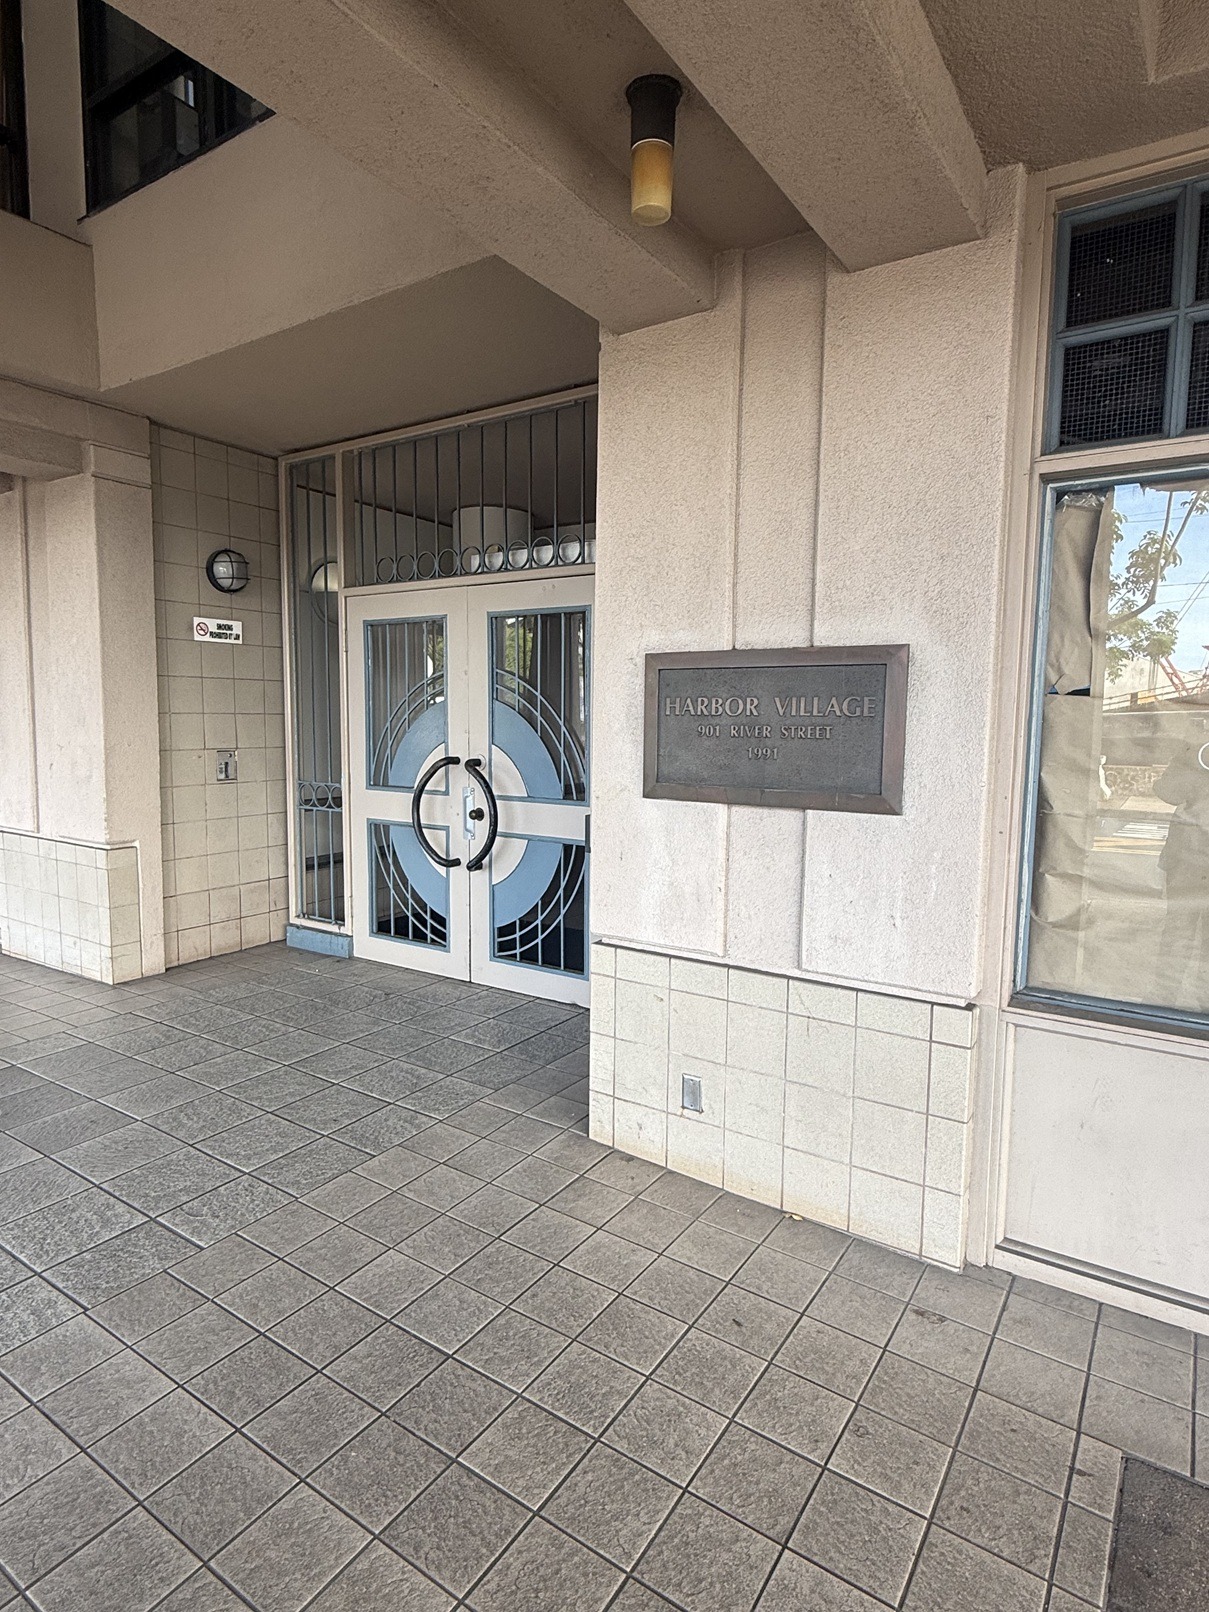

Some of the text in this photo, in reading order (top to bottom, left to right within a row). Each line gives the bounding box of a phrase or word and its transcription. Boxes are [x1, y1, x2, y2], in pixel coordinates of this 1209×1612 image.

[665, 697, 877, 718] HARBOR VILLAGE
[697, 725, 833, 739] 901 RIVER STREET
[747, 747, 779, 760] 1991
